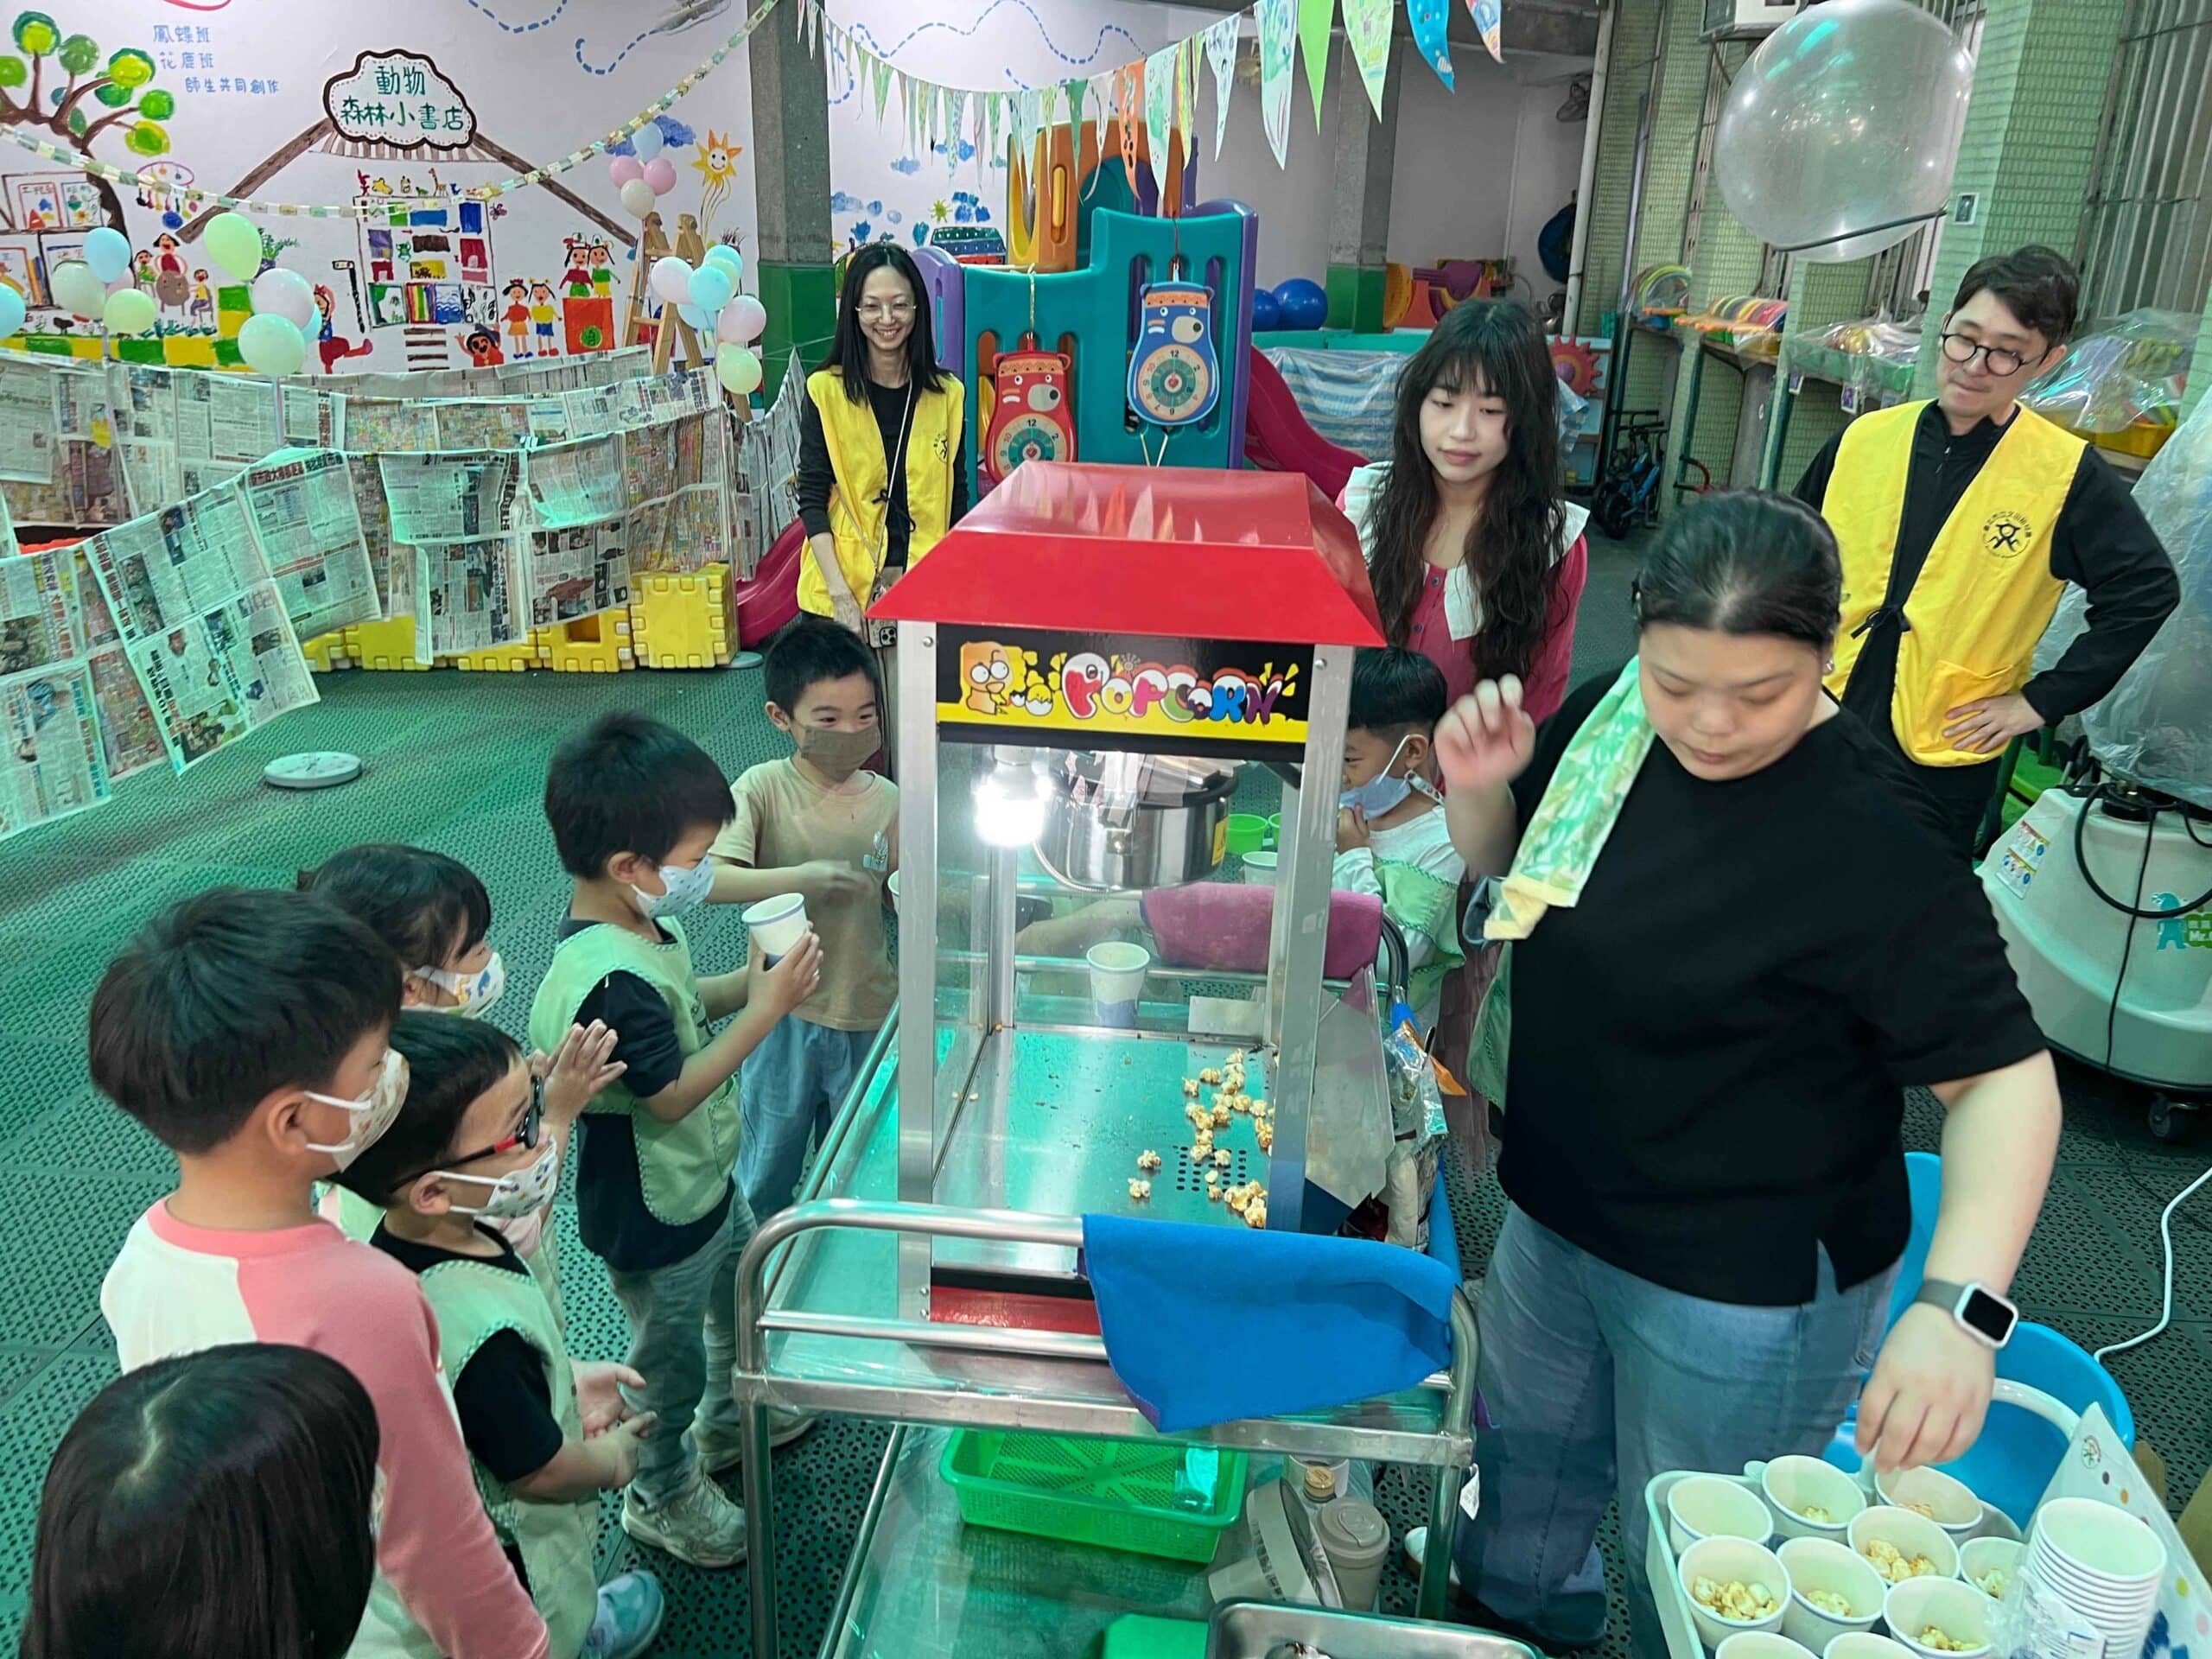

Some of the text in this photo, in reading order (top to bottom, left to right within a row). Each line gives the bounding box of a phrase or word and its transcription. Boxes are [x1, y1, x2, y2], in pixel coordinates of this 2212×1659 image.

[159, 51, 214, 69] 花鹿班
[185, 76, 279, 94] 師生共同創作
[374, 65, 426, 97] 動物
[340, 94, 464, 130] 森林小書店
[1027, 418, 1037, 427] 12
